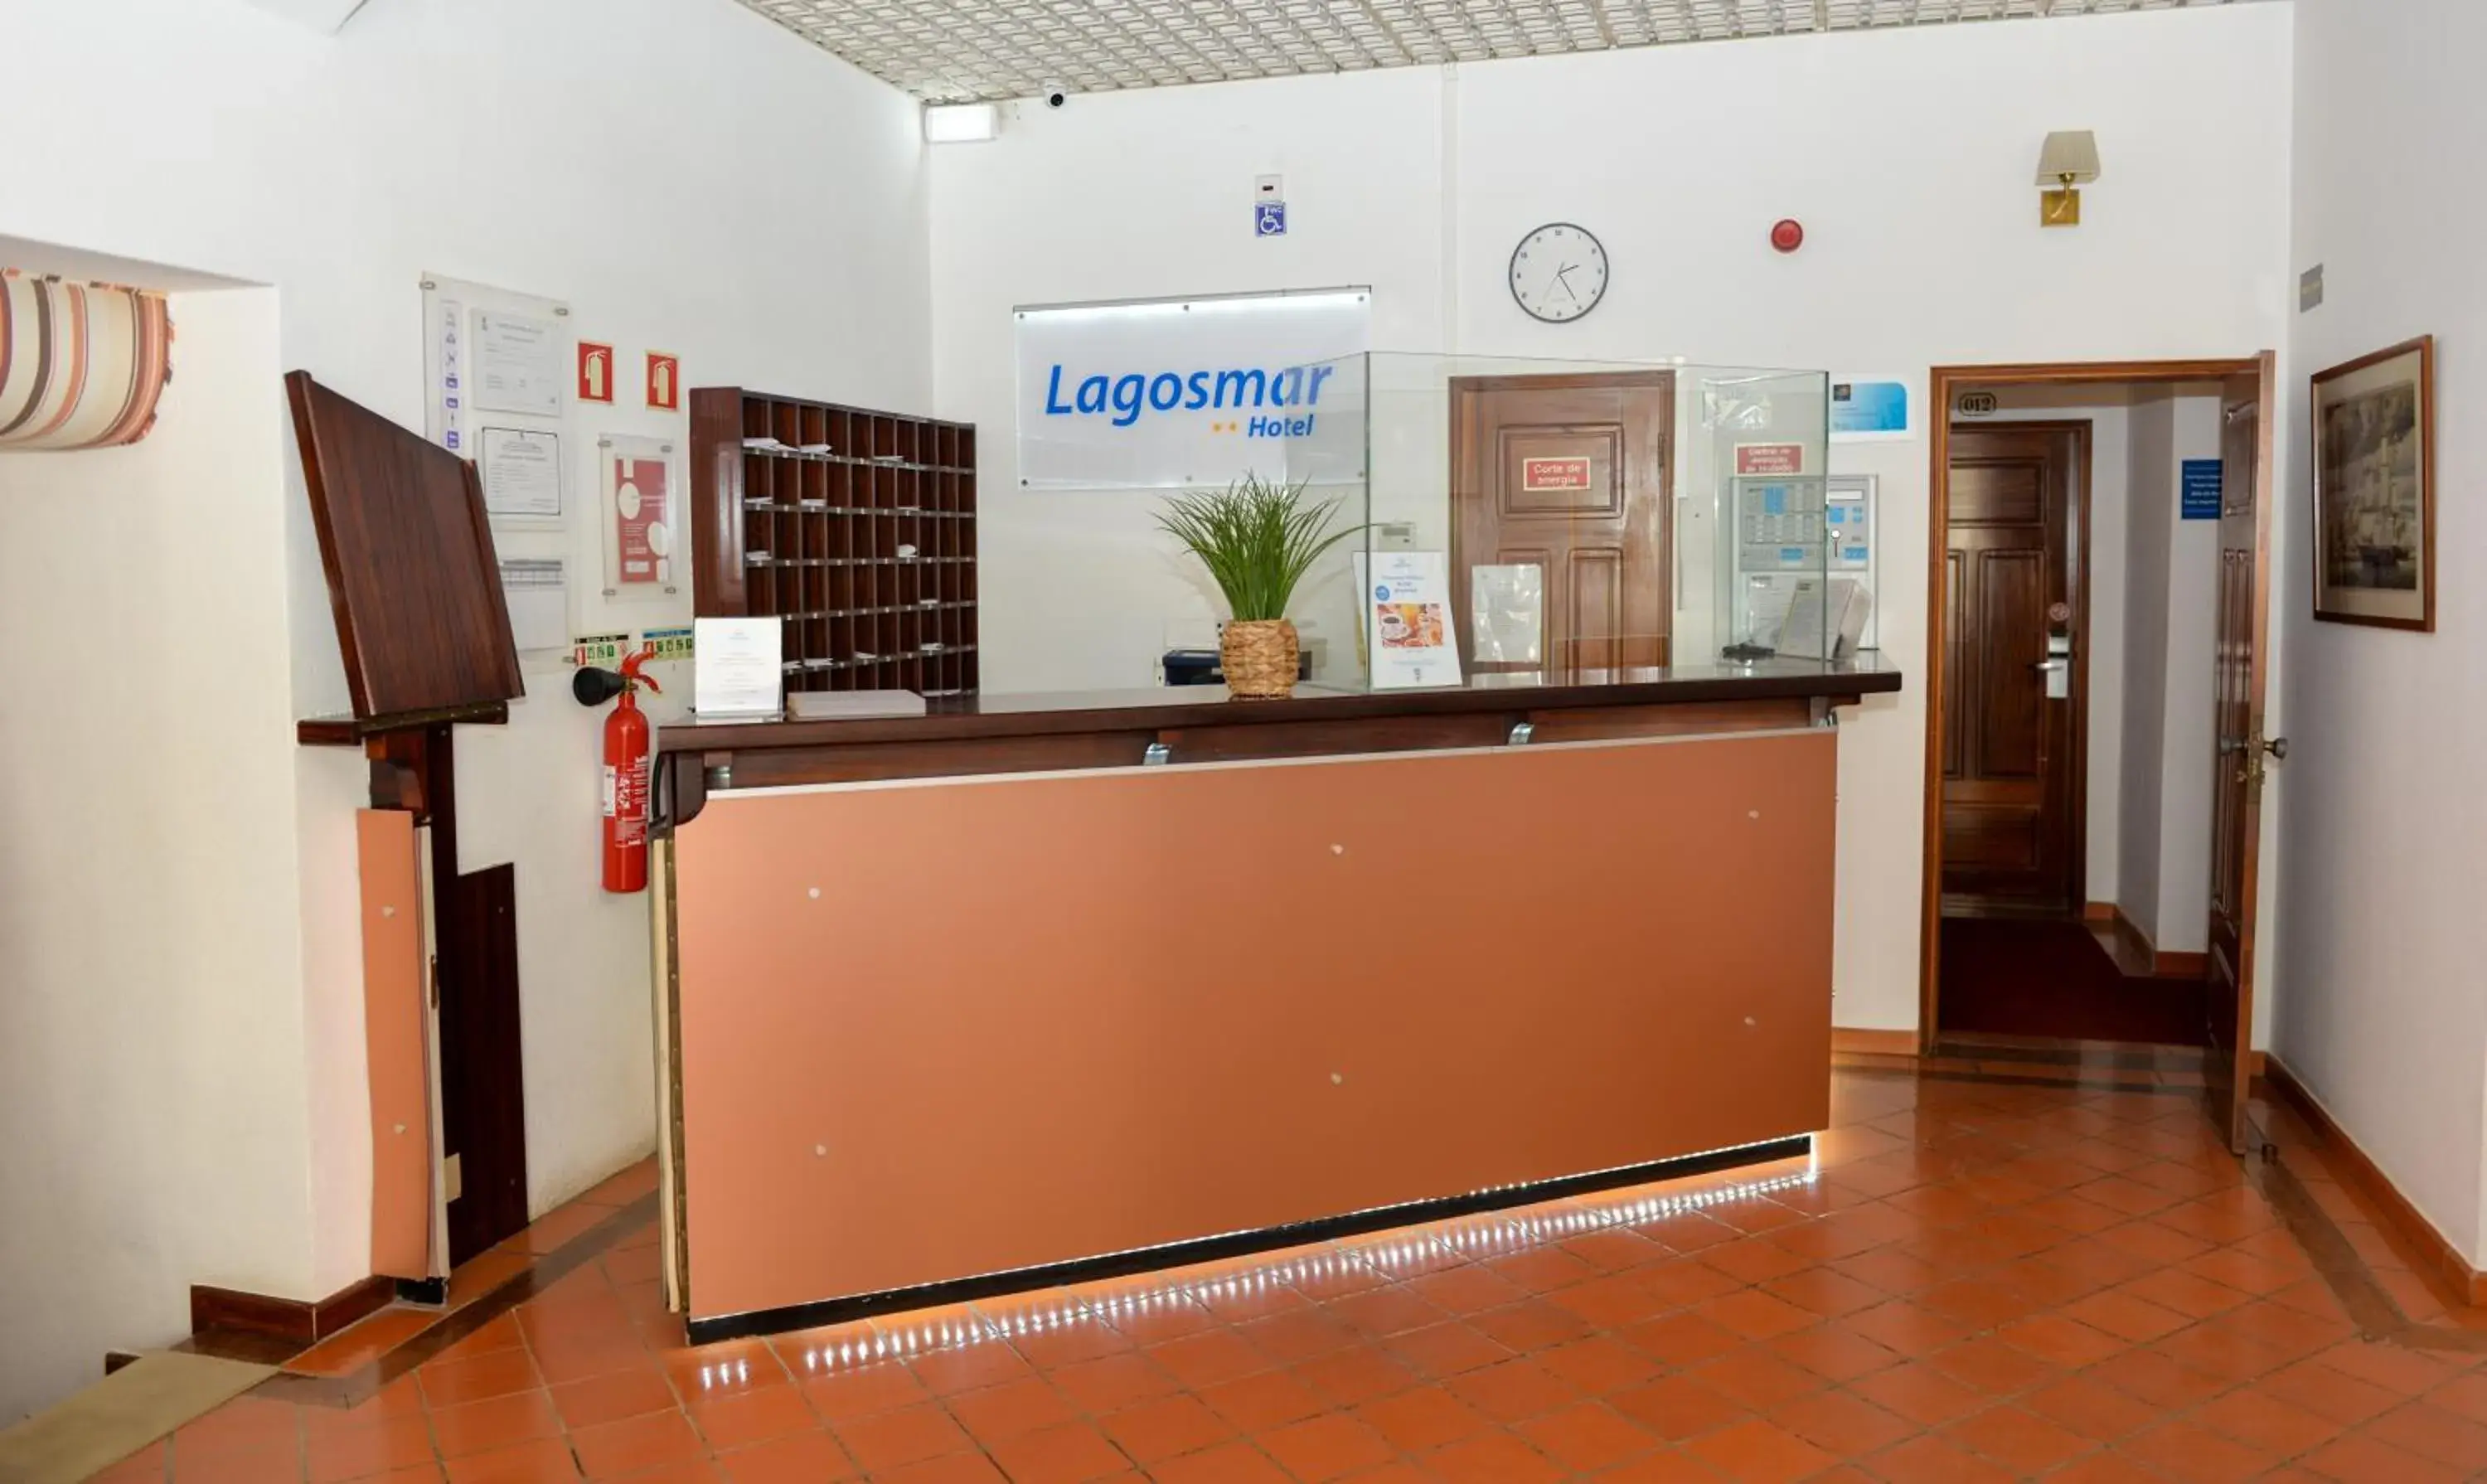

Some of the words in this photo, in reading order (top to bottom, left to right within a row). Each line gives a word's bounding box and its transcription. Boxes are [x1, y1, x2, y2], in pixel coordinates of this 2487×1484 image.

[1045, 364, 1333, 427] Lagosmar
[1964, 397, 1991, 412] 012
[1248, 414, 1314, 438] Hotel
[1534, 463, 1563, 474] Corte
[1567, 463, 1582, 473] de
